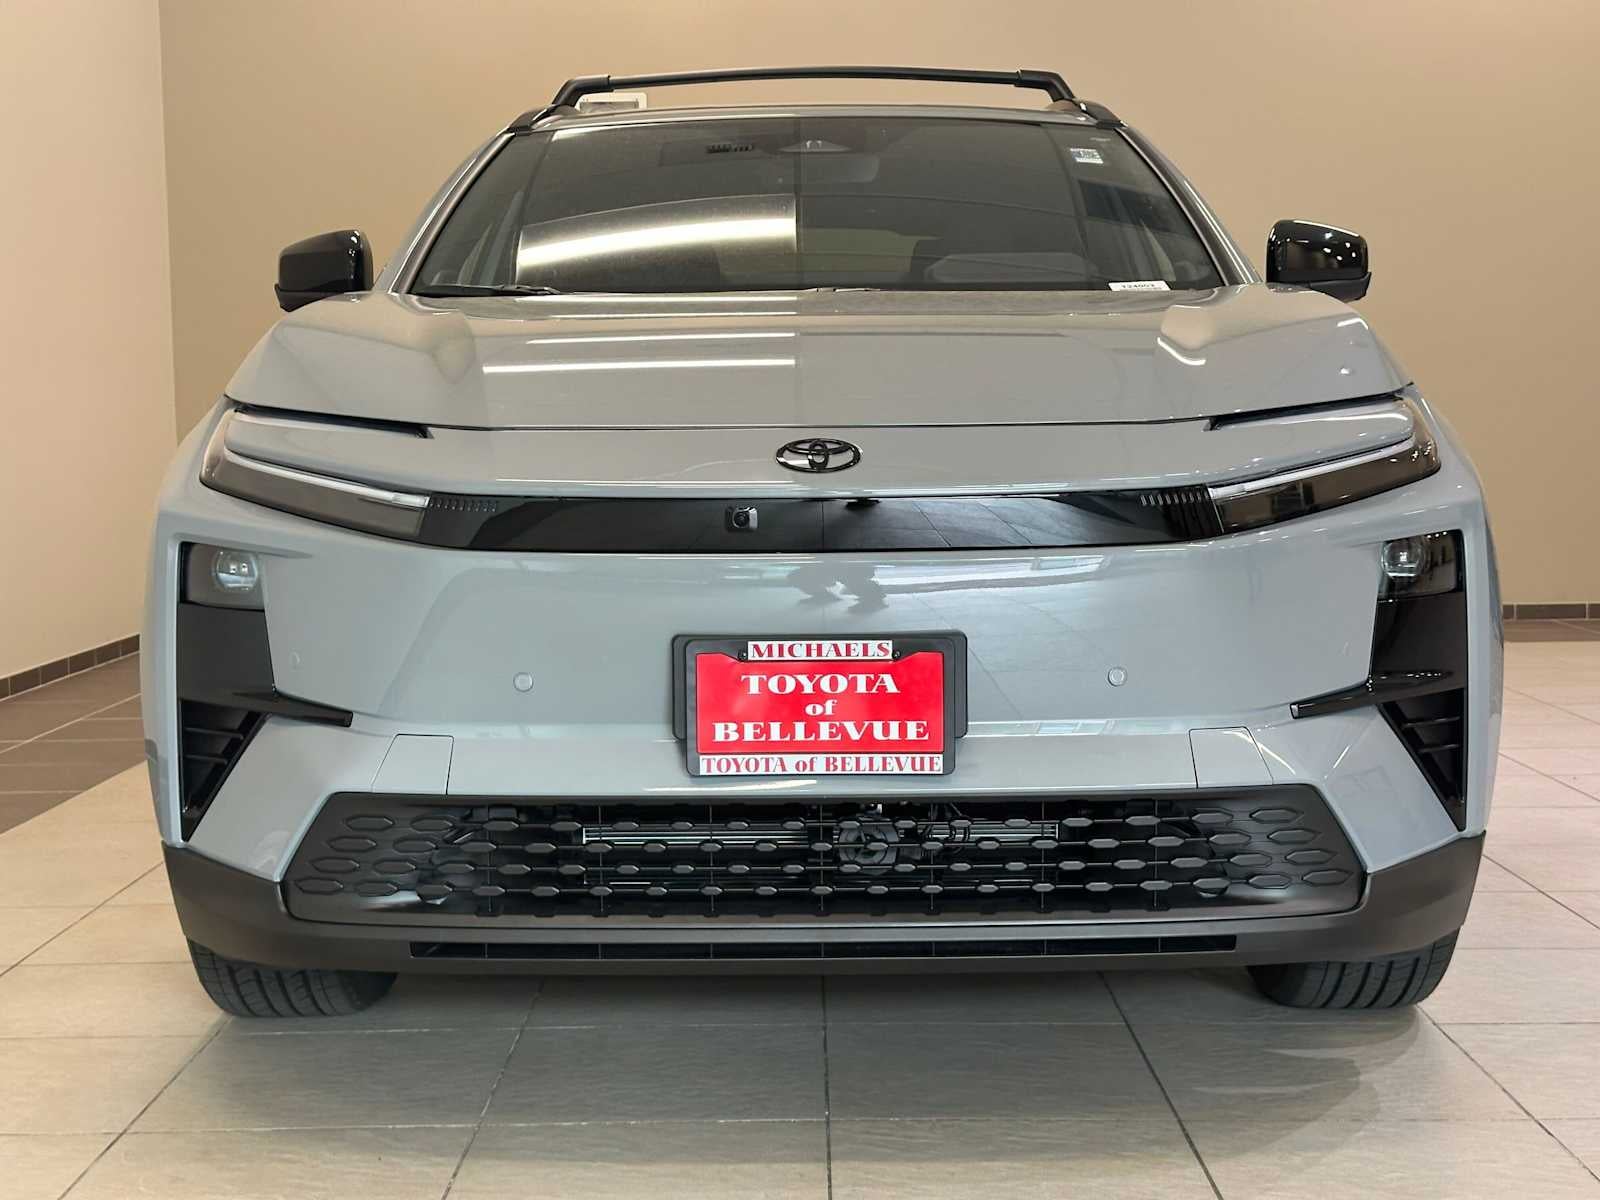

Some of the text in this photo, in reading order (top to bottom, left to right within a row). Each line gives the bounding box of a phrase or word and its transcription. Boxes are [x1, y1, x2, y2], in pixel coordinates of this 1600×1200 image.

[752, 643, 890, 658] MICHAELS
[741, 673, 901, 694] TOYOTA
[805, 699, 838, 716] of
[712, 720, 929, 742] BELLEVUE
[702, 755, 942, 773] TOYOTA of BELLEVUE
